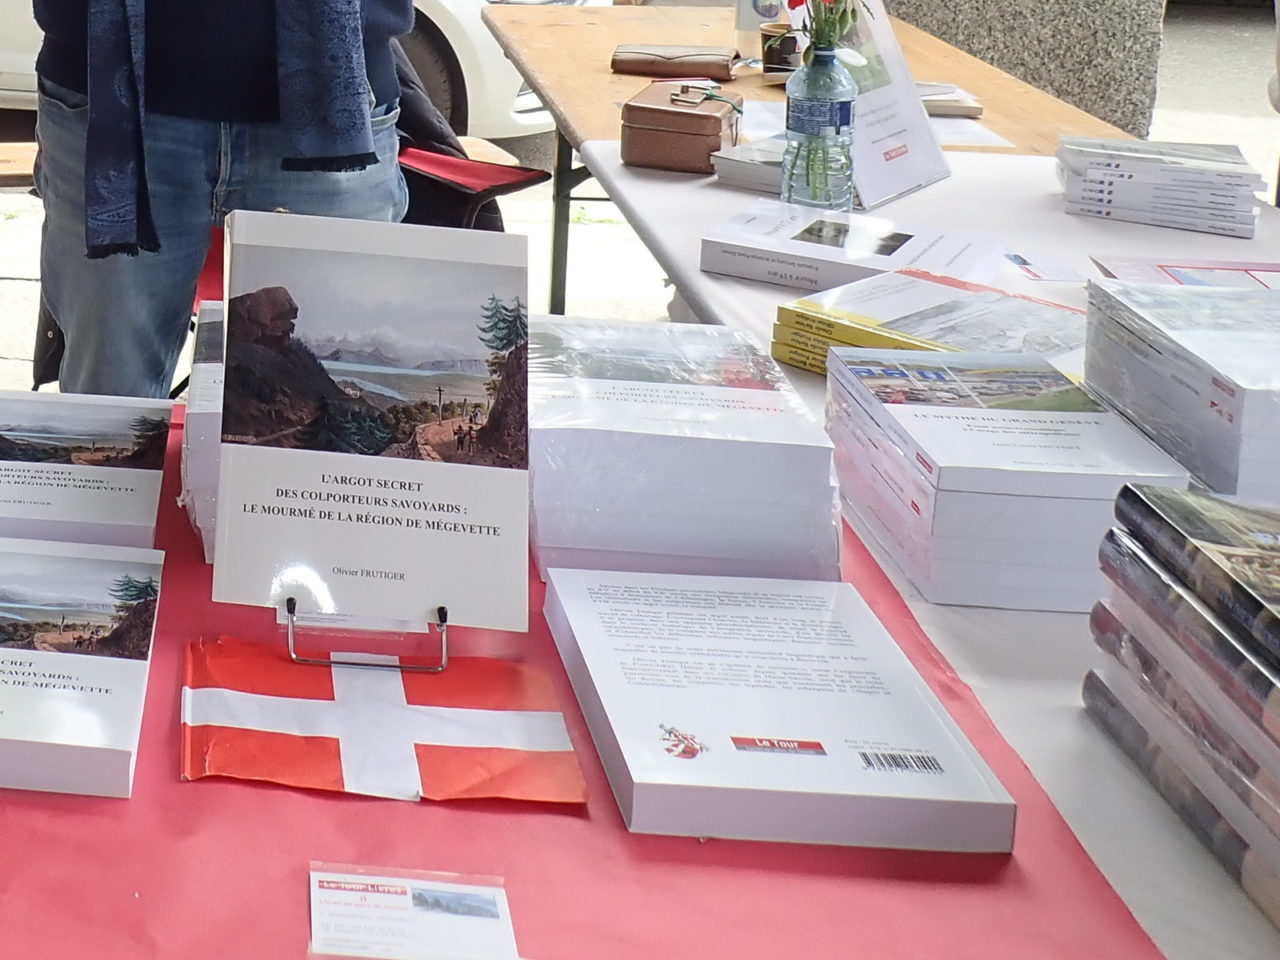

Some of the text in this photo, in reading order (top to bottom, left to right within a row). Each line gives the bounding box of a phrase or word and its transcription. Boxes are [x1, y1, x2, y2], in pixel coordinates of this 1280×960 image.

[34, 468, 73, 476] SECRET
[45, 475, 106, 485] SAVOYARDS
[321, 473, 424, 492] L'ARGOT SECRET
[275, 488, 299, 499] DES
[300, 490, 389, 508] COLPORTEURS
[390, 498, 462, 514] SAVOYARDS
[242, 503, 501, 537] LE MOURMÉ DE LA RÉGION DE MÉGEVETTE
[332, 565, 406, 582] Olivier FRUTIGER
[11, 679, 31, 688] DE
[32, 680, 113, 695] MÉGEVETTE
[754, 737, 800, 750] Le Tour
